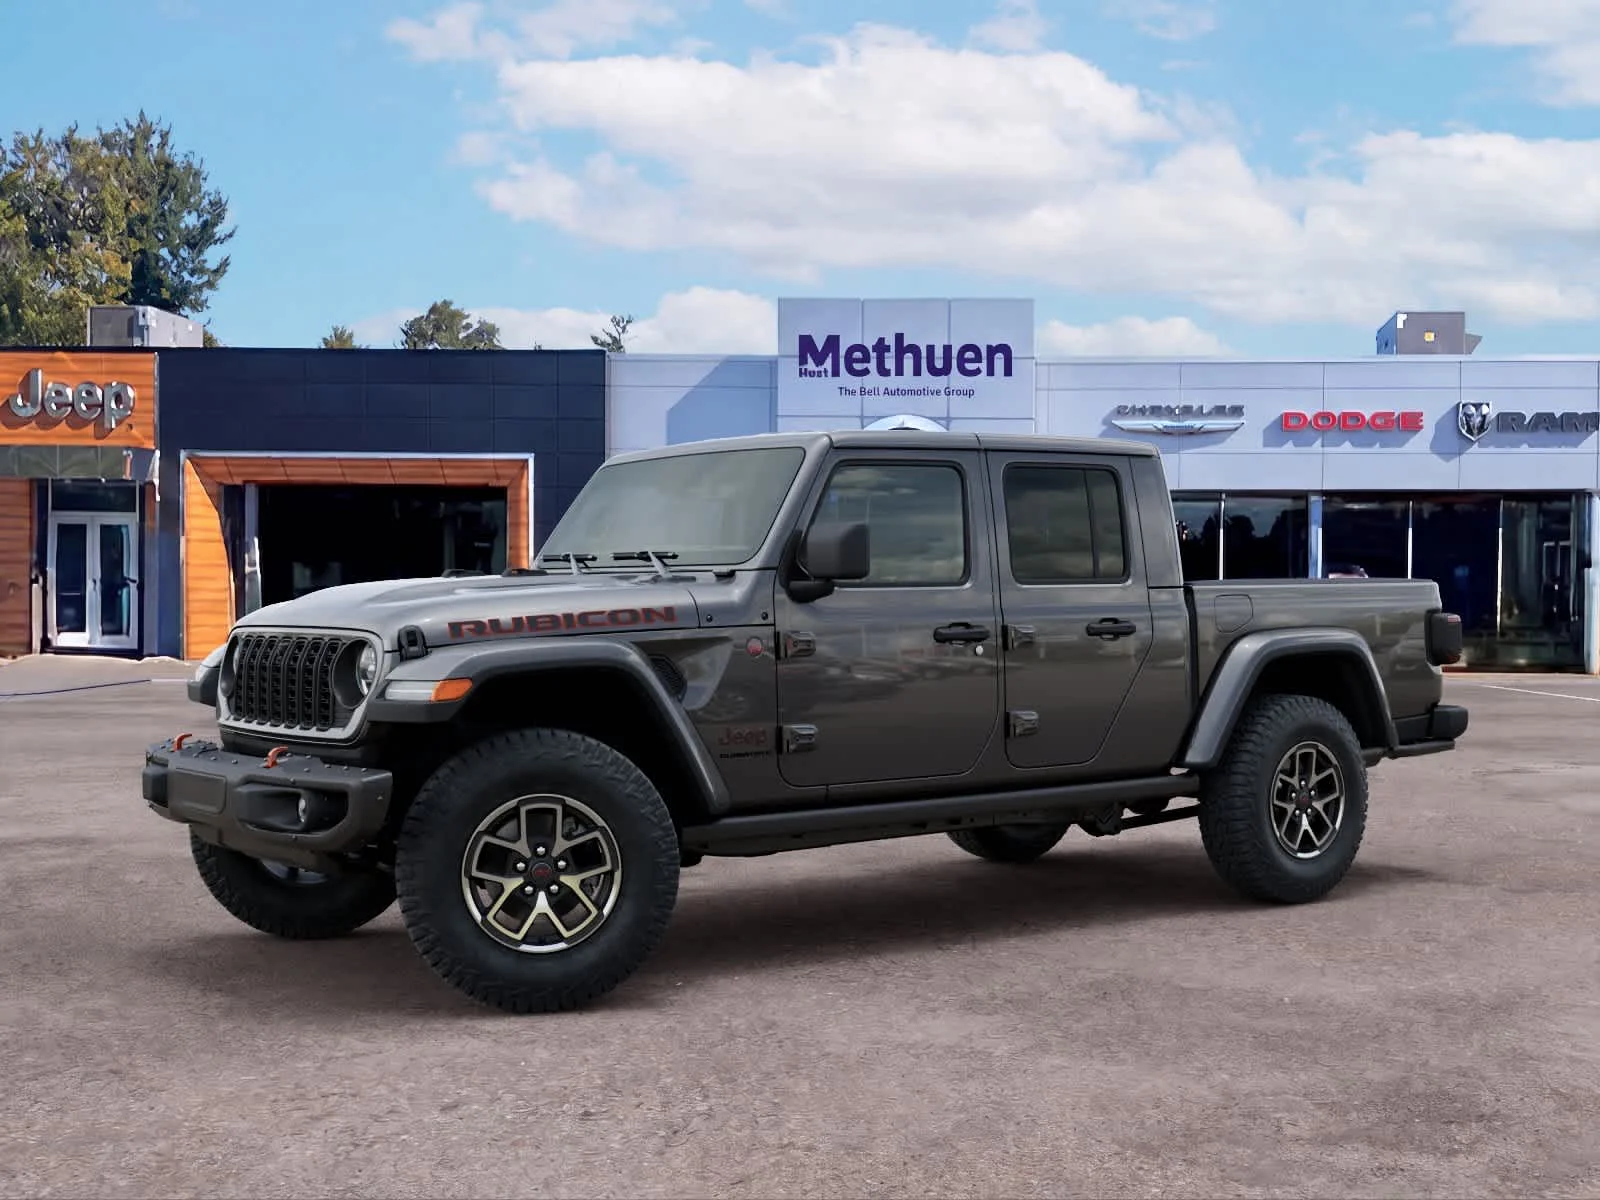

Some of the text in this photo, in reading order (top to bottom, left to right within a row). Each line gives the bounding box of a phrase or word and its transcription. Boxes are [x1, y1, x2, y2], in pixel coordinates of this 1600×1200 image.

[798, 333, 1013, 378] Methuen
[8, 367, 136, 429] Jeep
[838, 386, 975, 399] The Bell Automotive Group
[1281, 410, 1424, 432] DODGE
[1497, 411, 1599, 433] RAM
[447, 606, 678, 639] RUBICON
